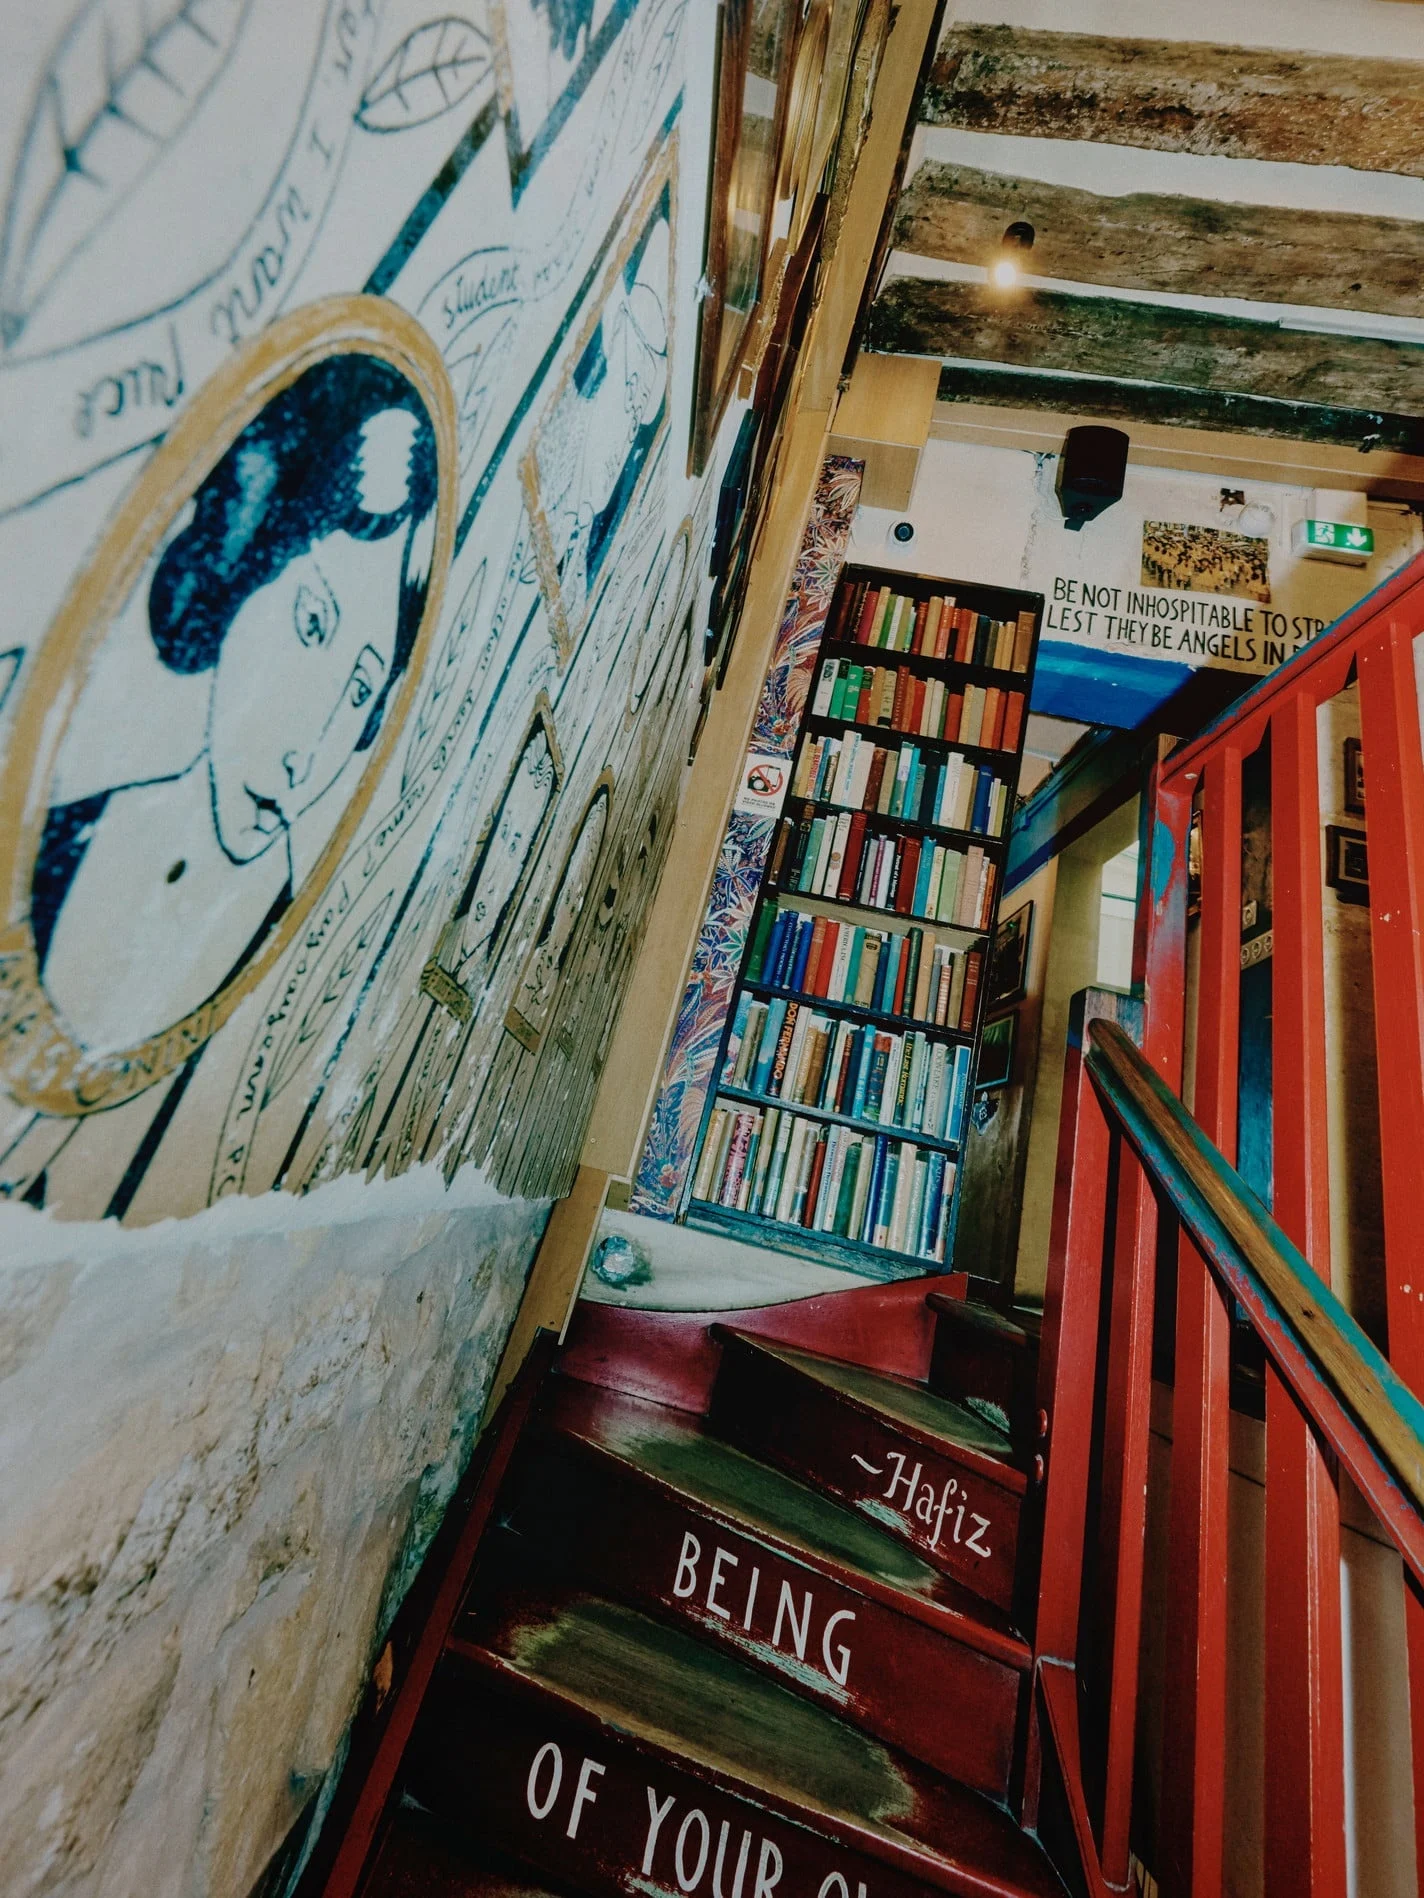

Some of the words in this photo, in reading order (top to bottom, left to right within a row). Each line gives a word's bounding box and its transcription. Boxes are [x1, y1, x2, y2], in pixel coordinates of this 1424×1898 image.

[1046, 604, 1098, 636] LEST
[1104, 614, 1149, 644] THEY
[1151, 624, 1173, 650] BE
[1177, 628, 1256, 662] ANGELS
[1263, 640, 1285, 666] IN
[1054, 577, 1078, 603] BE
[1082, 583, 1121, 612] NOT
[1127, 591, 1254, 633] INHOSPITABLE
[1259, 610, 1287, 638] TO
[1292, 616, 1334, 641] STR
[785, 1001, 799, 1025] DON
[772, 1025, 794, 1081] FERNANDO
[673, 1531, 856, 1687] BEING
[527, 1742, 606, 1840] OF
[642, 1786, 783, 1898] YOUR
